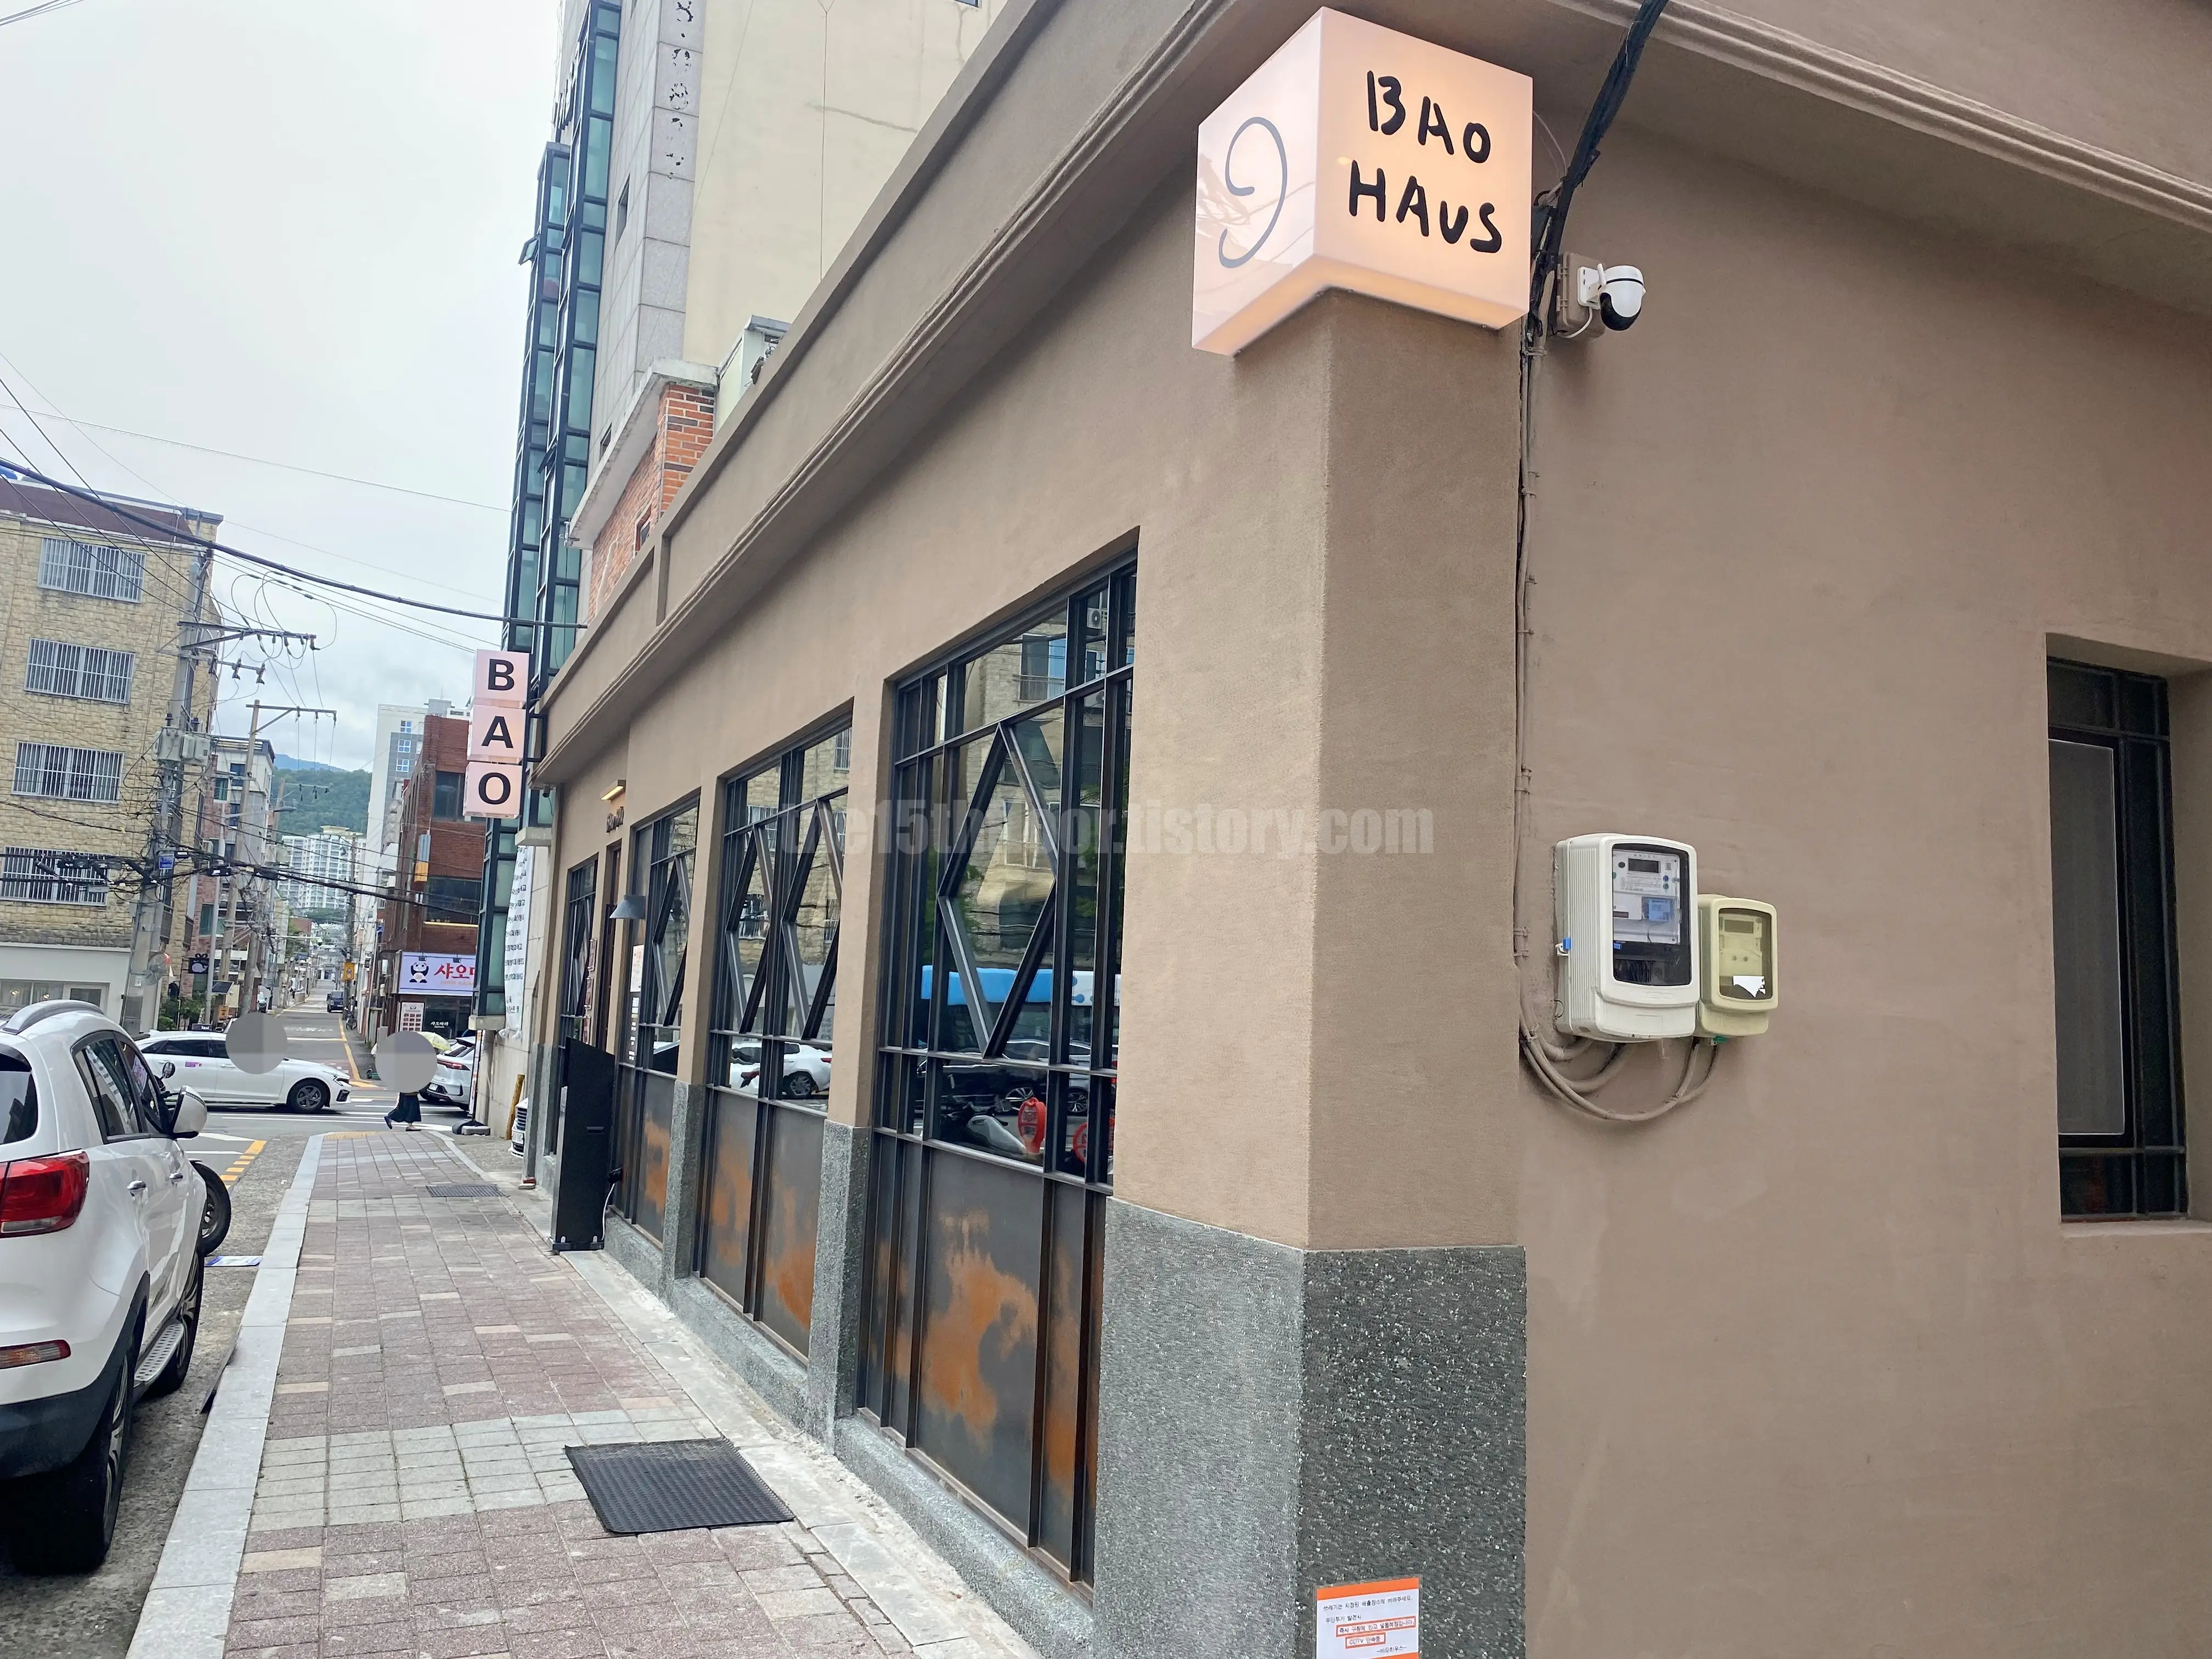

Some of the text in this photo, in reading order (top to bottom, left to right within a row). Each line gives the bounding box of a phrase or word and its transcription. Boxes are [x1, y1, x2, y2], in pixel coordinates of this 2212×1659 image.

[1367, 70, 1491, 163] BAO
[1348, 160, 1502, 253] HAUS
[478, 658, 515, 805] BAO
[1325, 1615, 1345, 1623] 무단투기
